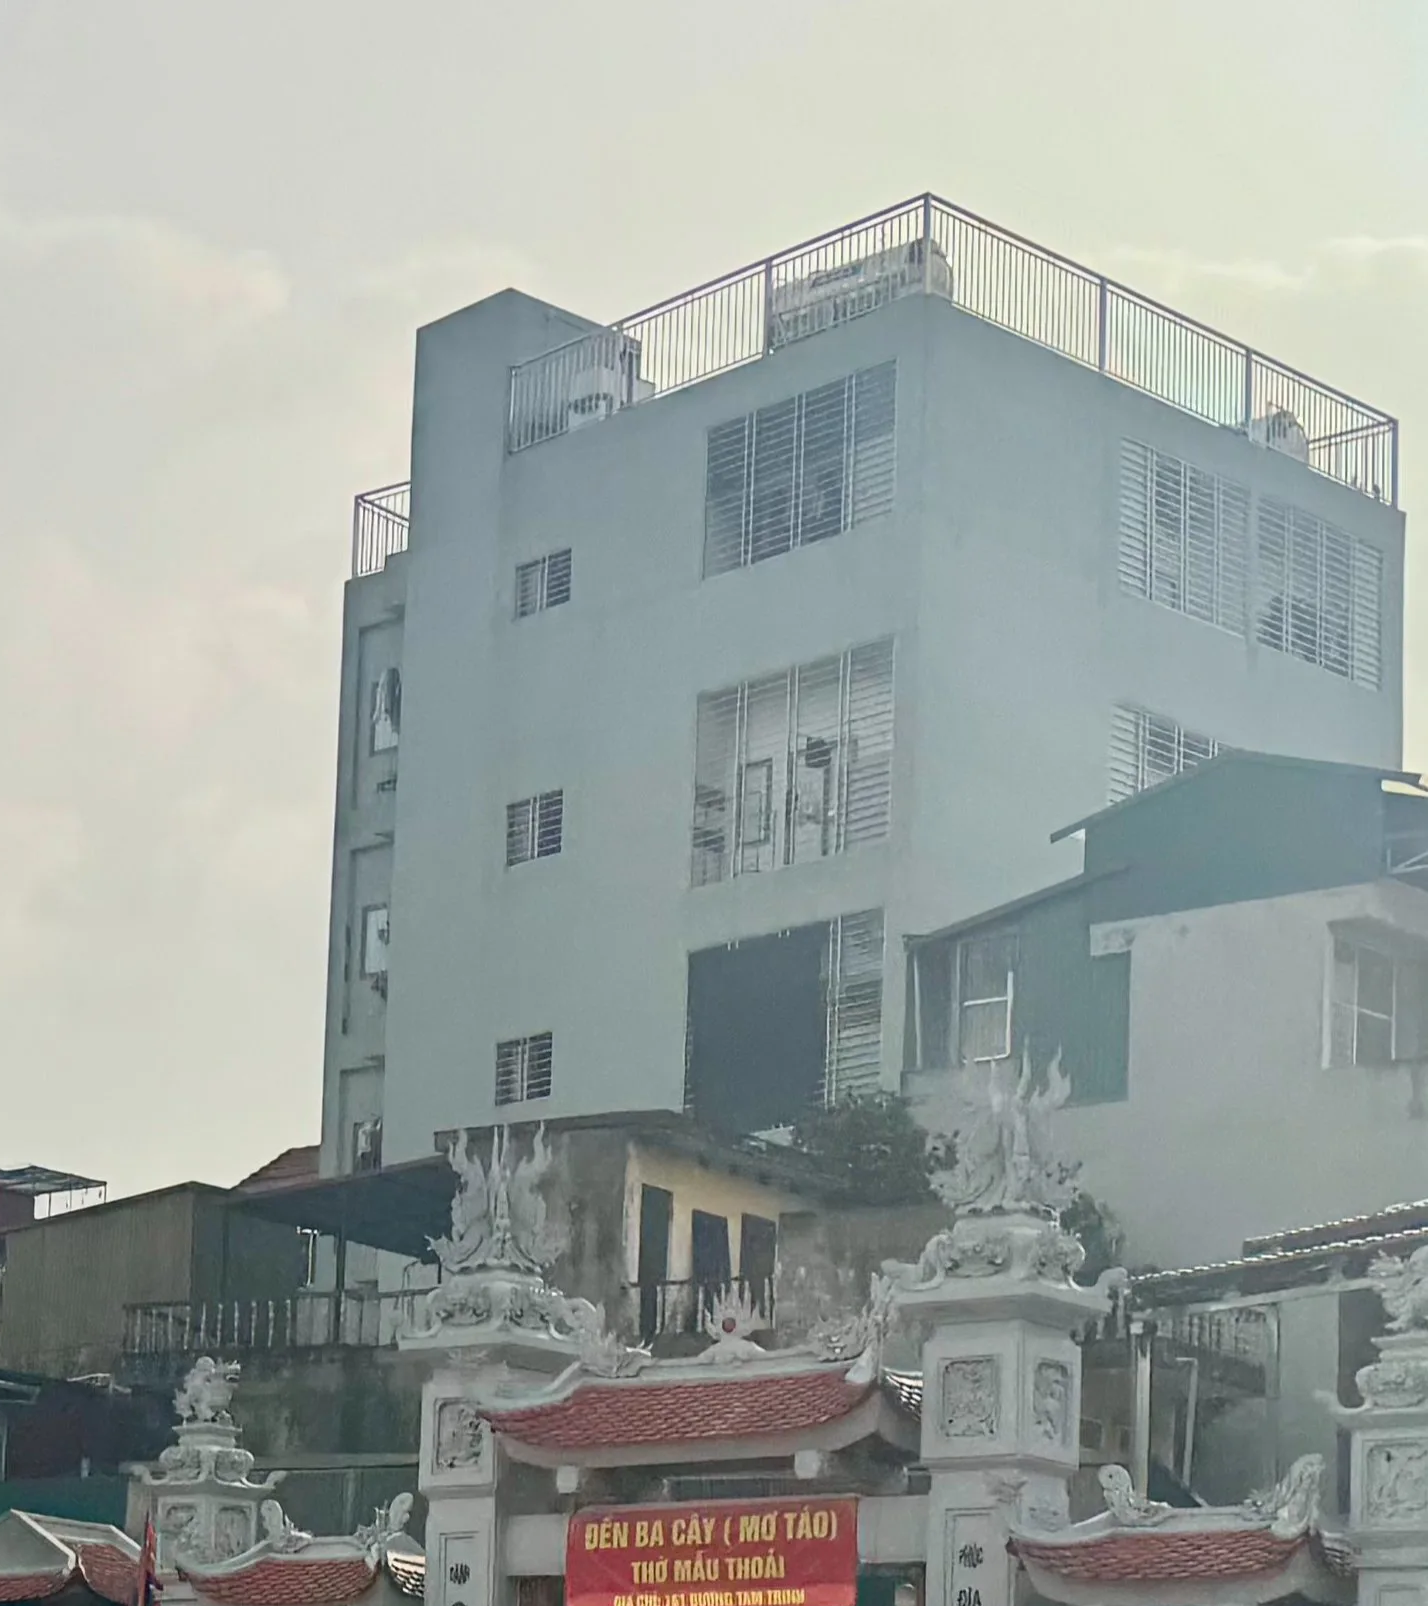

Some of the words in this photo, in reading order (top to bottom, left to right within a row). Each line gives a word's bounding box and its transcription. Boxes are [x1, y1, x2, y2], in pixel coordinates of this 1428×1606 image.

[635, 1519, 664, 1547] BA
[671, 1512, 715, 1545] CÂY
[739, 1510, 779, 1542] MƠ
[783, 1504, 837, 1541] TÁO)
